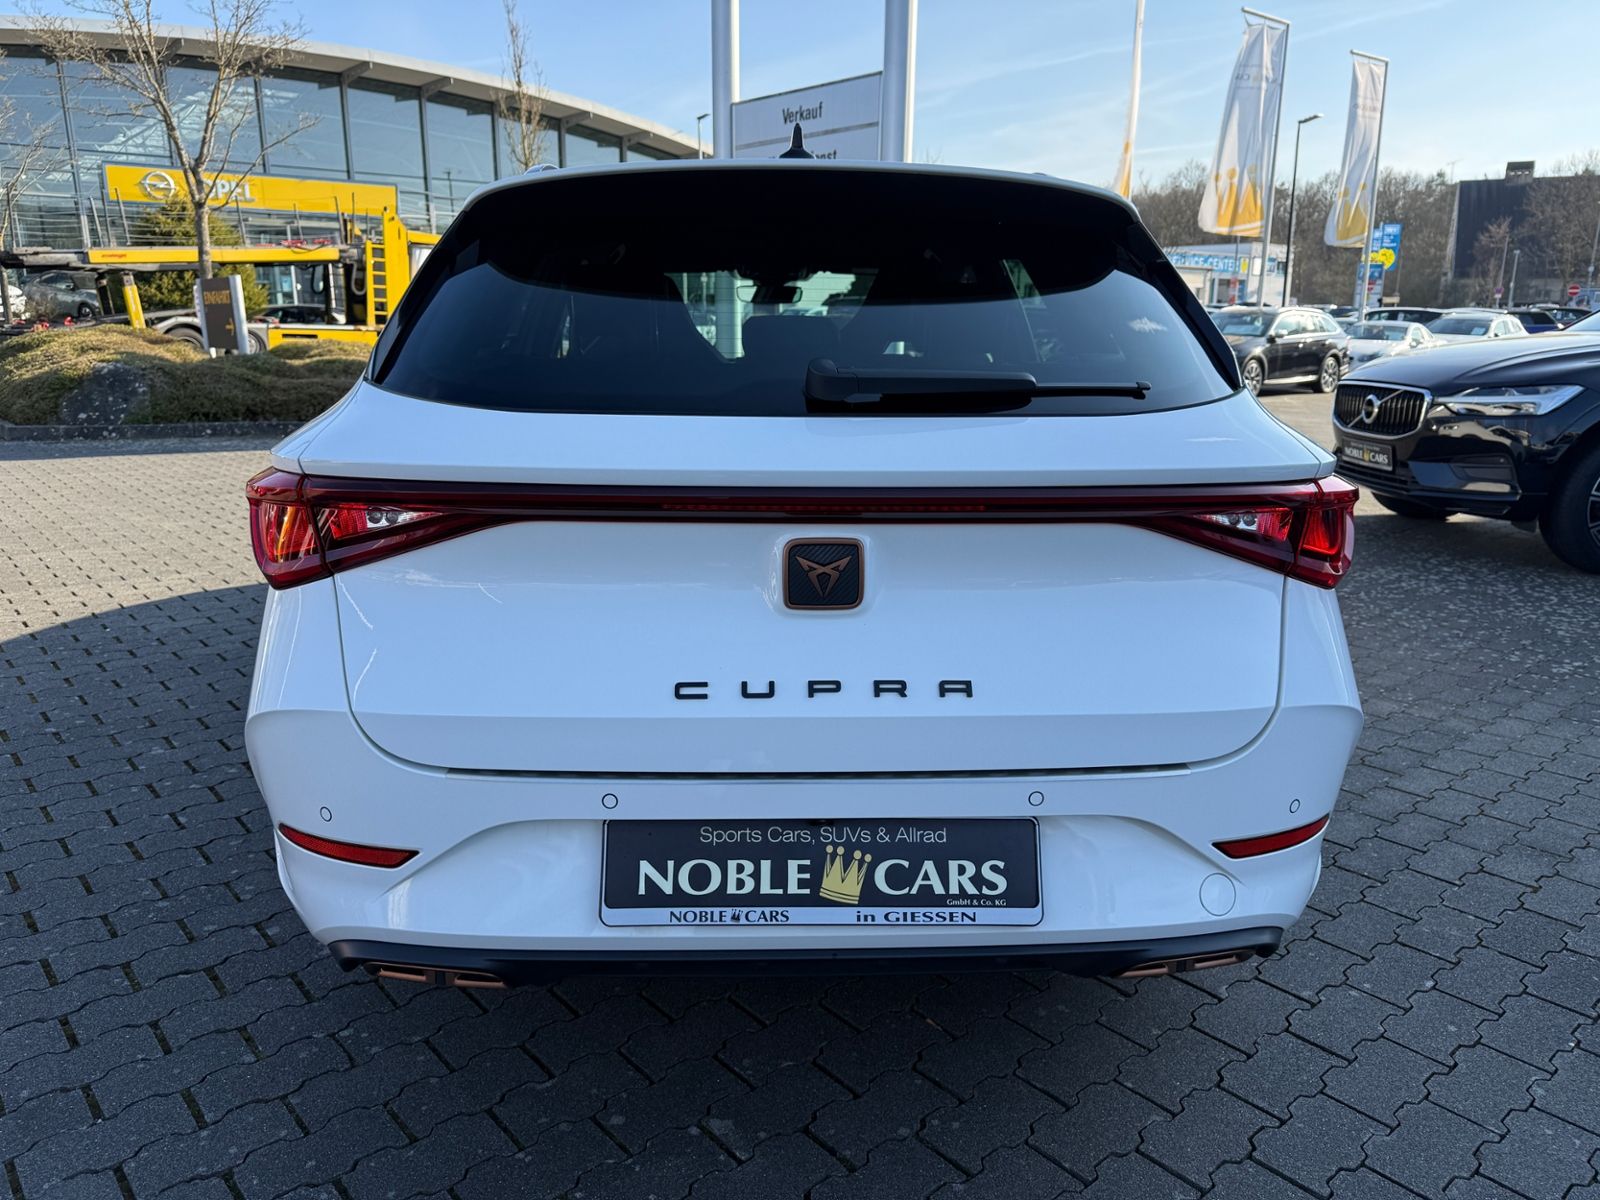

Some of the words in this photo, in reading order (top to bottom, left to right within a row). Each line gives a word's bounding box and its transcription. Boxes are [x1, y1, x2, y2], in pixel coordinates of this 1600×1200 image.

[782, 101, 824, 124] Verkauf
[1370, 452, 1388, 464] CARS
[674, 679, 974, 700] CUPRA
[700, 826, 762, 846] Sports
[767, 826, 815, 845] Cars,
[820, 826, 871, 843] SUVs
[876, 827, 891, 843] &
[895, 827, 947, 843] Allrad
[638, 859, 811, 896] NOBLE
[874, 859, 1008, 896] CARS
[669, 910, 727, 923] NOBLE
[744, 910, 790, 923] CARS
[856, 910, 876, 923] in
[883, 911, 976, 923] GIESSEN
